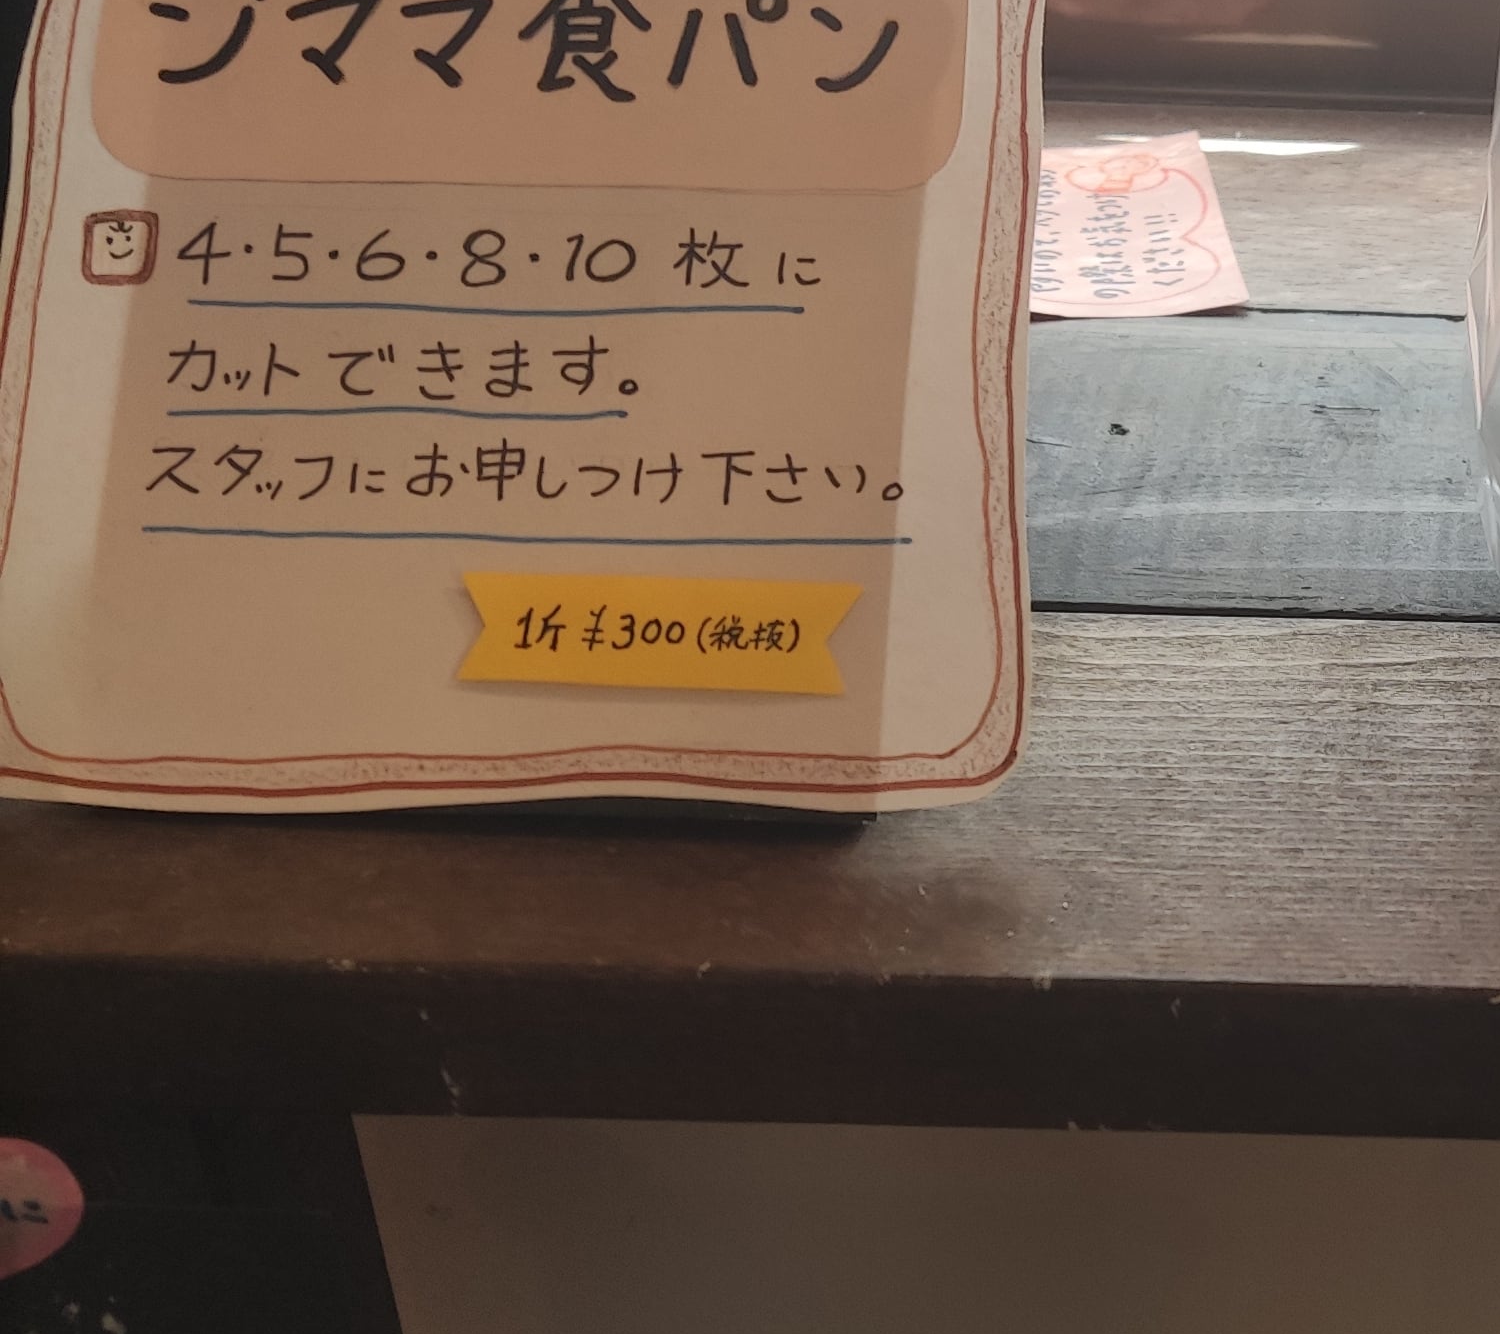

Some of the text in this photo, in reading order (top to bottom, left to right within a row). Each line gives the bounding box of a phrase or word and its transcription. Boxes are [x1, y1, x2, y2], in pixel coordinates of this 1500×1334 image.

[167, 334, 641, 402] カットできます。
[145, 437, 905, 506] スタッフにお申しつけ下さい。
